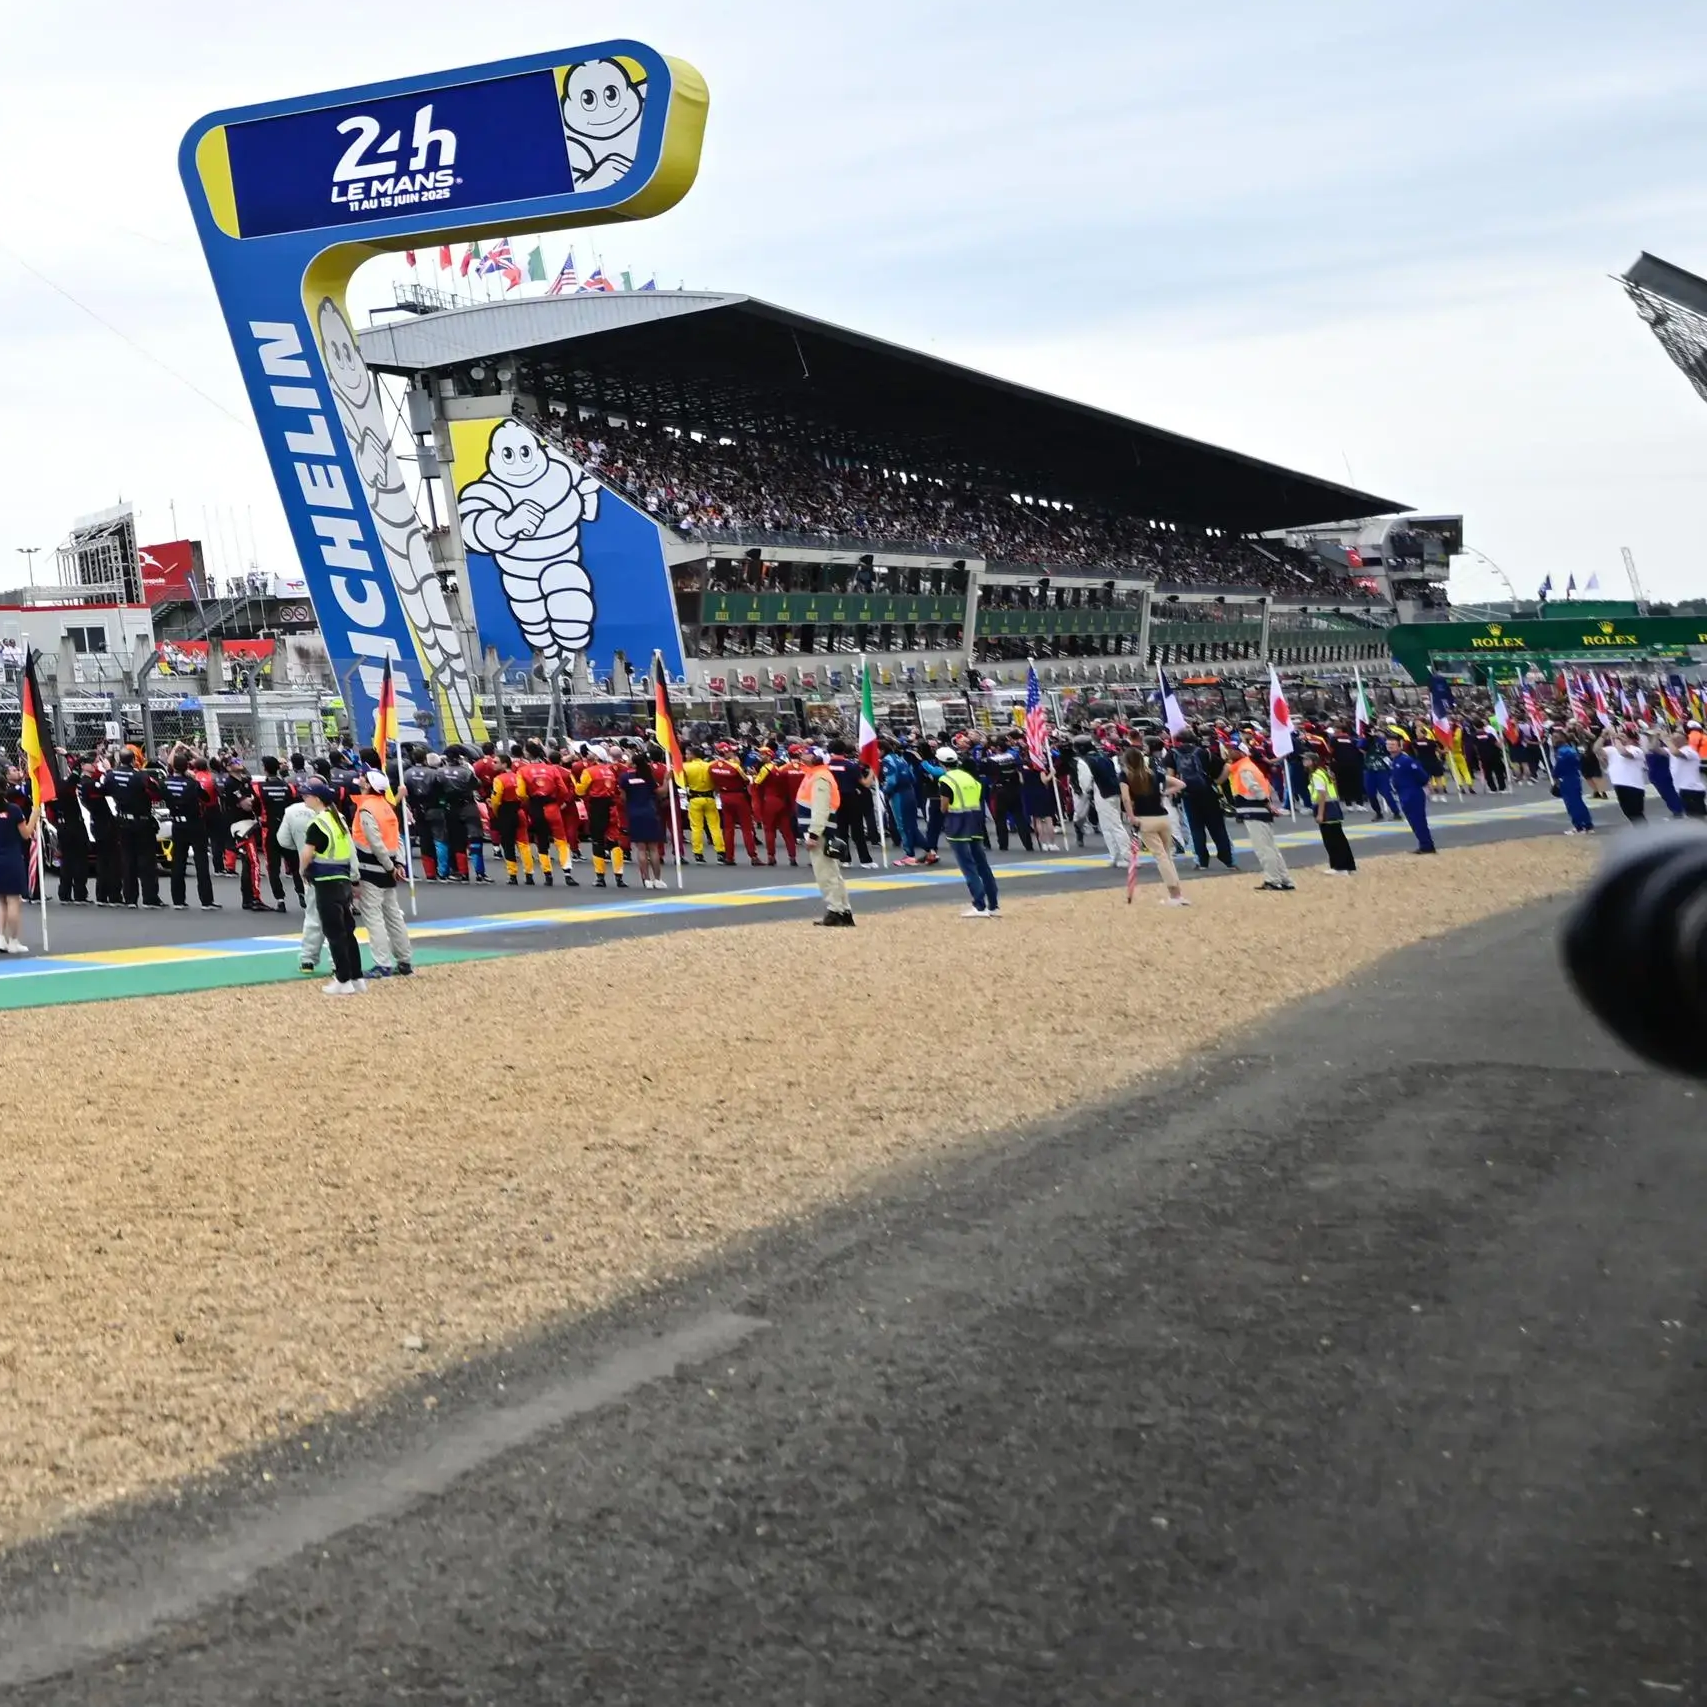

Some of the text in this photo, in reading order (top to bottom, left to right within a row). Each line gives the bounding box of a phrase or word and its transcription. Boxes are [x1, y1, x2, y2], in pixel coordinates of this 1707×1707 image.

[333, 104, 456, 182] 24h
[331, 169, 453, 203] LE MANS
[349, 188, 450, 211] 11 AU 15 JUIN 2025
[249, 320, 428, 744] MICHELIN
[1471, 637, 1525, 647] ROLEX
[1582, 634, 1638, 645] ROLEX
